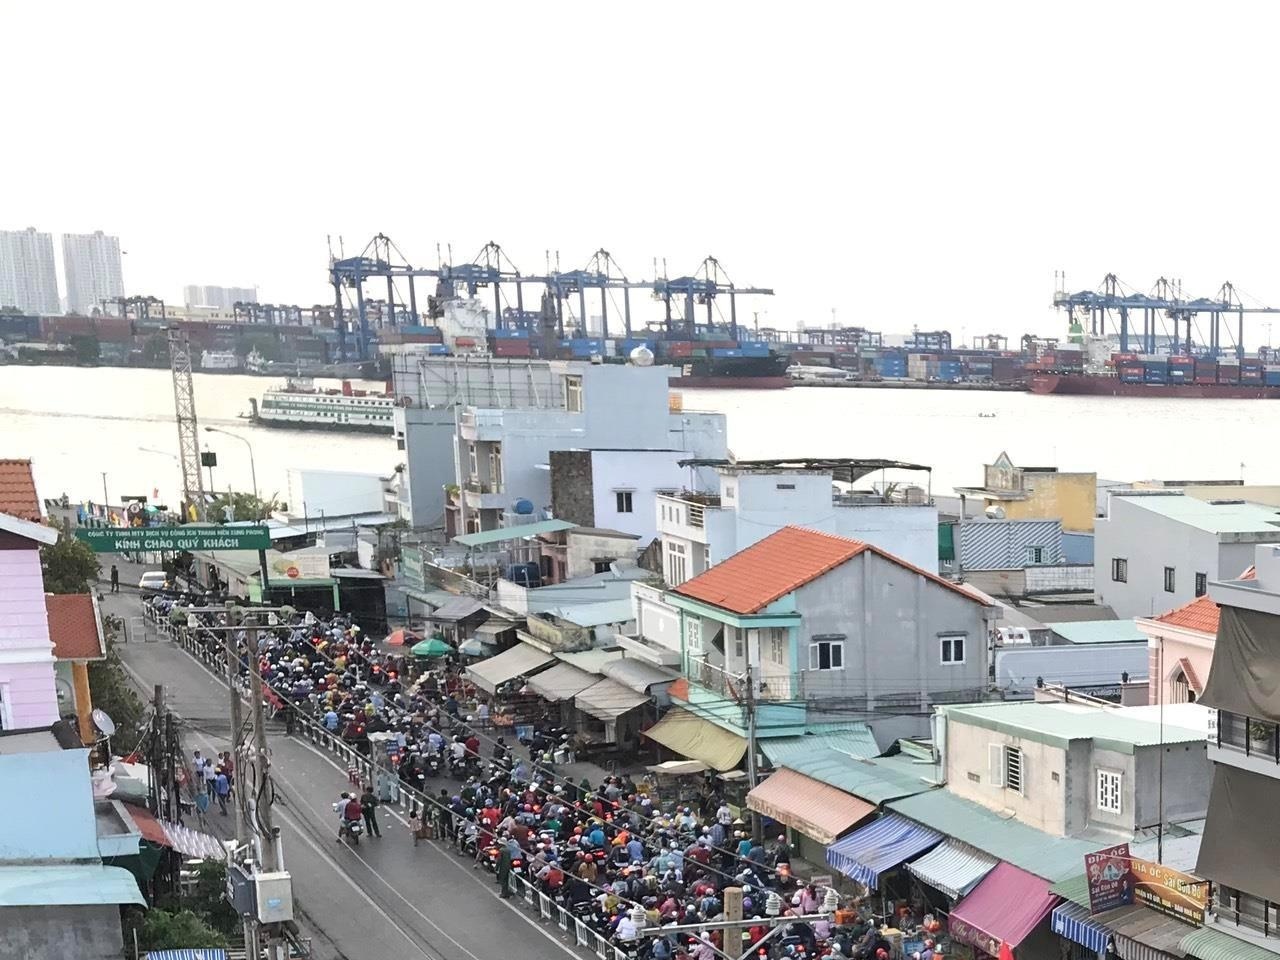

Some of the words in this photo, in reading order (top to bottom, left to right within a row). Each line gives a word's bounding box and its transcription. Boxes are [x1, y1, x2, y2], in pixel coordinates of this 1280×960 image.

[115, 537, 140, 549] KÍNH
[144, 536, 173, 549] CHÀO
[177, 536, 199, 549] QUÝ
[203, 536, 239, 547] KHÁCH
